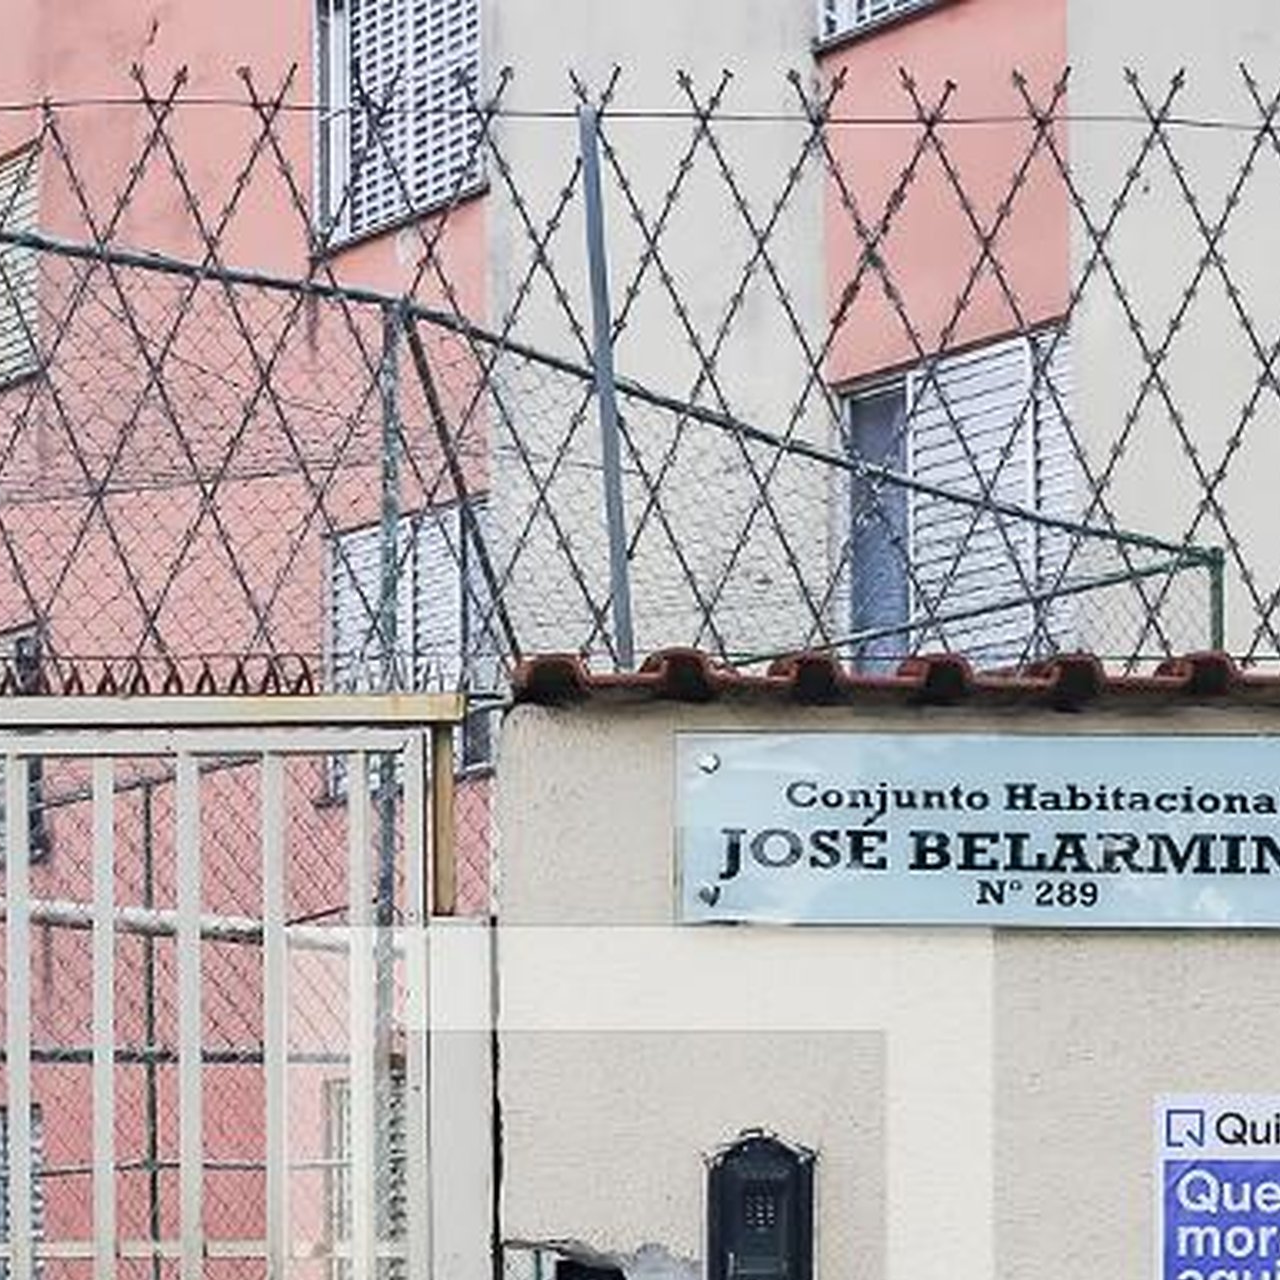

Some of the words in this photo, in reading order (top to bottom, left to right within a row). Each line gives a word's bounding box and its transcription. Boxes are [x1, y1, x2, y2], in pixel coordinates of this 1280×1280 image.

[785, 780, 991, 815] Conjunto
[720, 811, 888, 879] JOSÉ
[1035, 881, 1099, 908] 289
